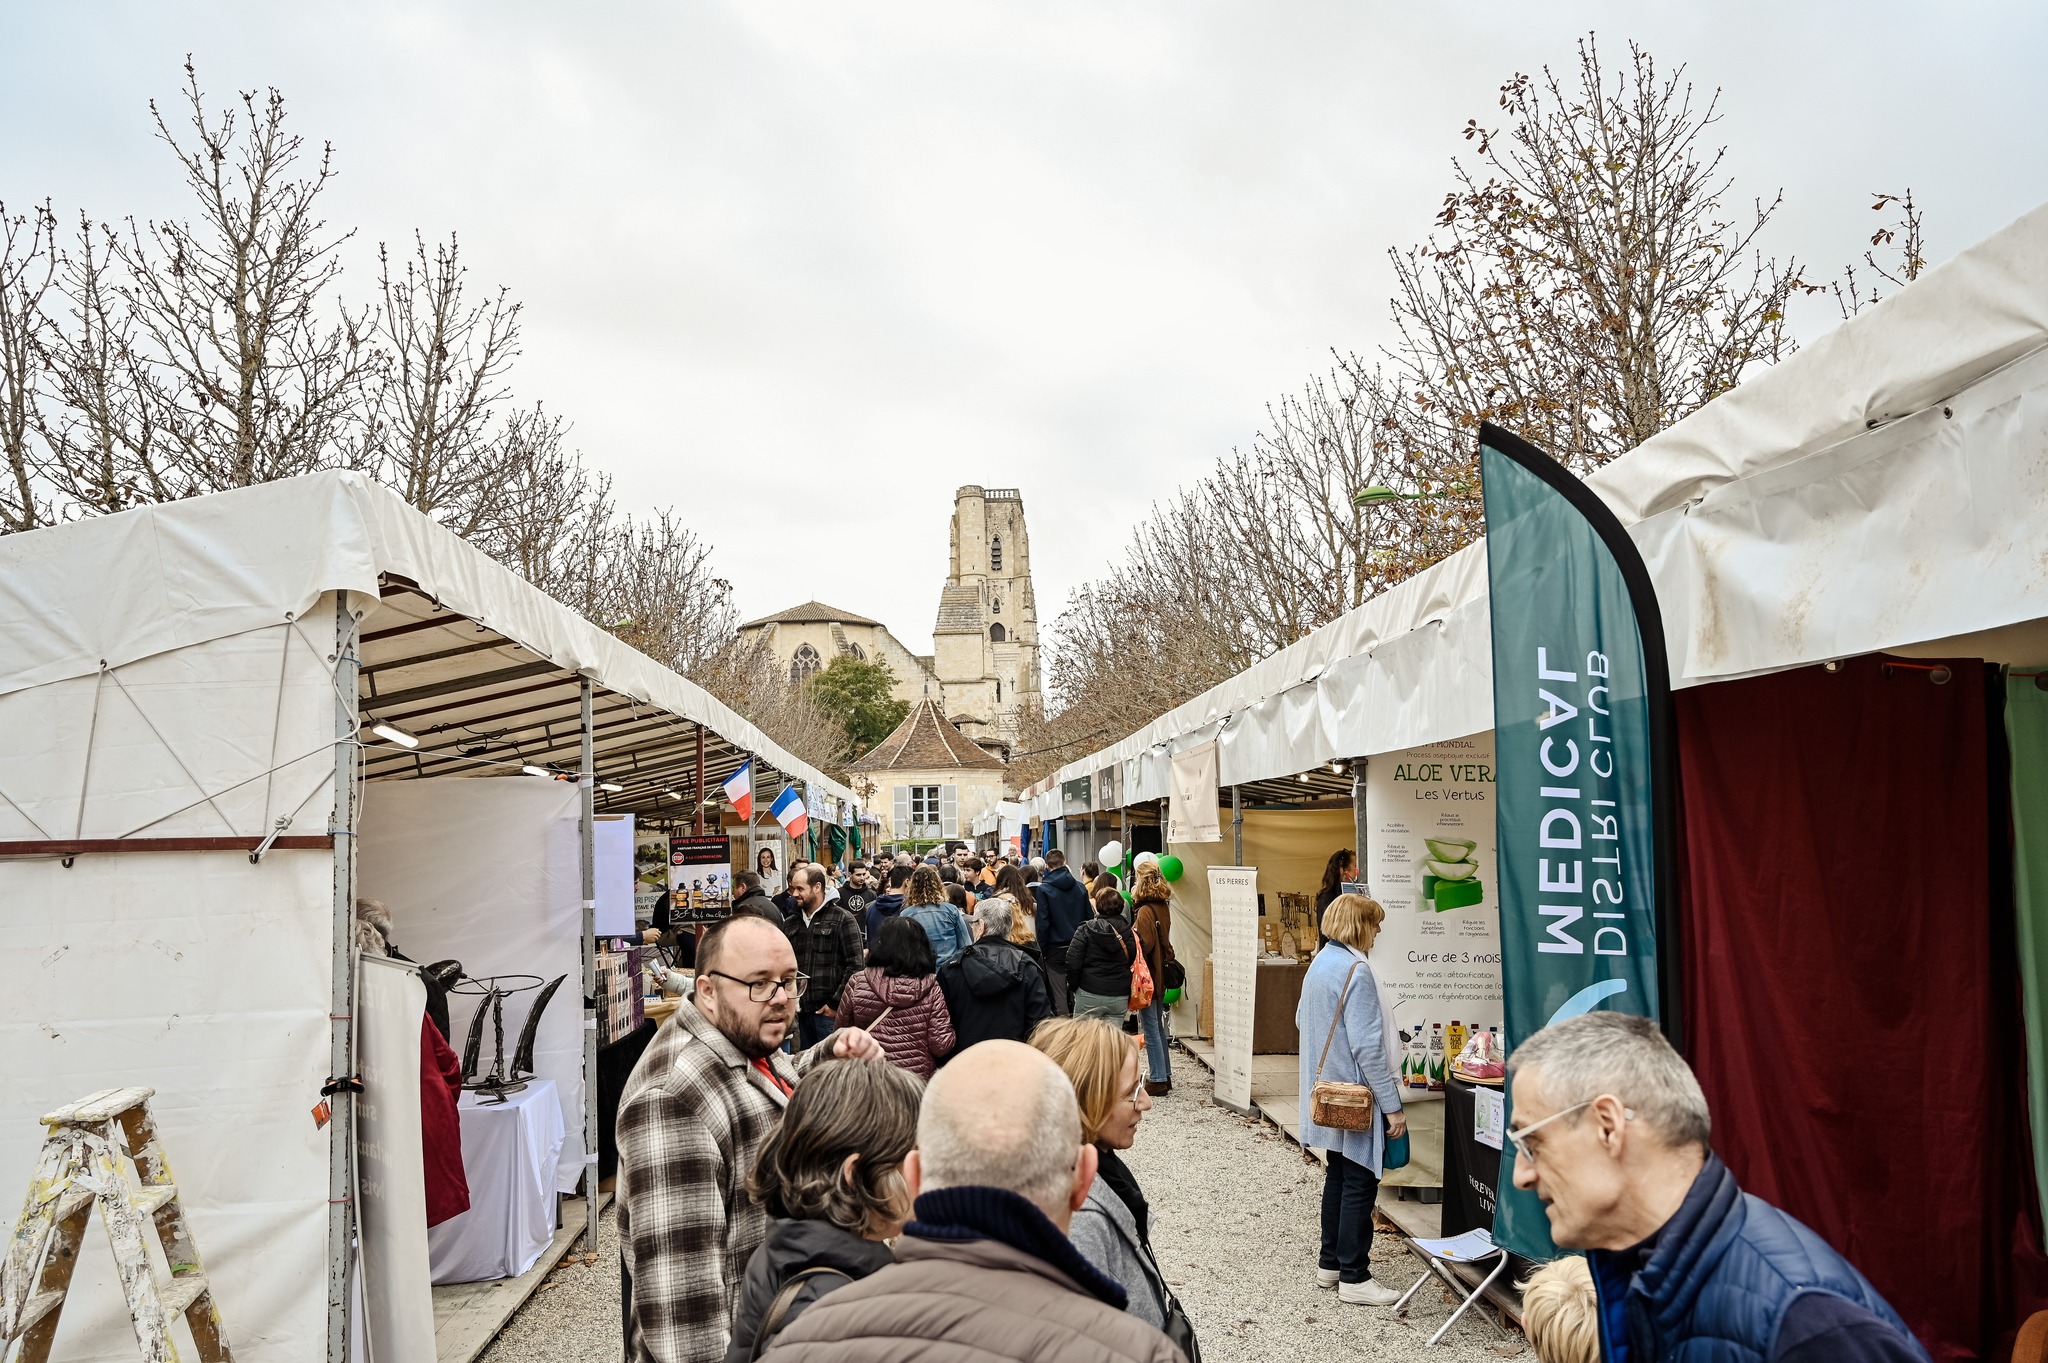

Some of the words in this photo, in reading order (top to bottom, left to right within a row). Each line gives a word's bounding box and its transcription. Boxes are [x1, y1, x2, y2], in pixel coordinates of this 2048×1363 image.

[1437, 741, 1475, 749] MONDIAL
[1433, 752, 1464, 760] aseptique
[1393, 763, 1443, 782] ALOE
[1449, 764, 1497, 783] VER
[1415, 789, 1439, 800] Les
[1442, 788, 1485, 801] Vertus
[1216, 877, 1226, 885] LES
[1226, 878, 1249, 886] PIERRES
[1407, 950, 1438, 963] Cure
[1442, 952, 1457, 963] de
[1461, 951, 1470, 964] 3
[1473, 952, 1502, 964] mois
[1447, 970, 1495, 979] détoxification
[1419, 981, 1442, 989] remise
[1453, 982, 1483, 990] fonction
[1438, 993, 1483, 1003] régénération
